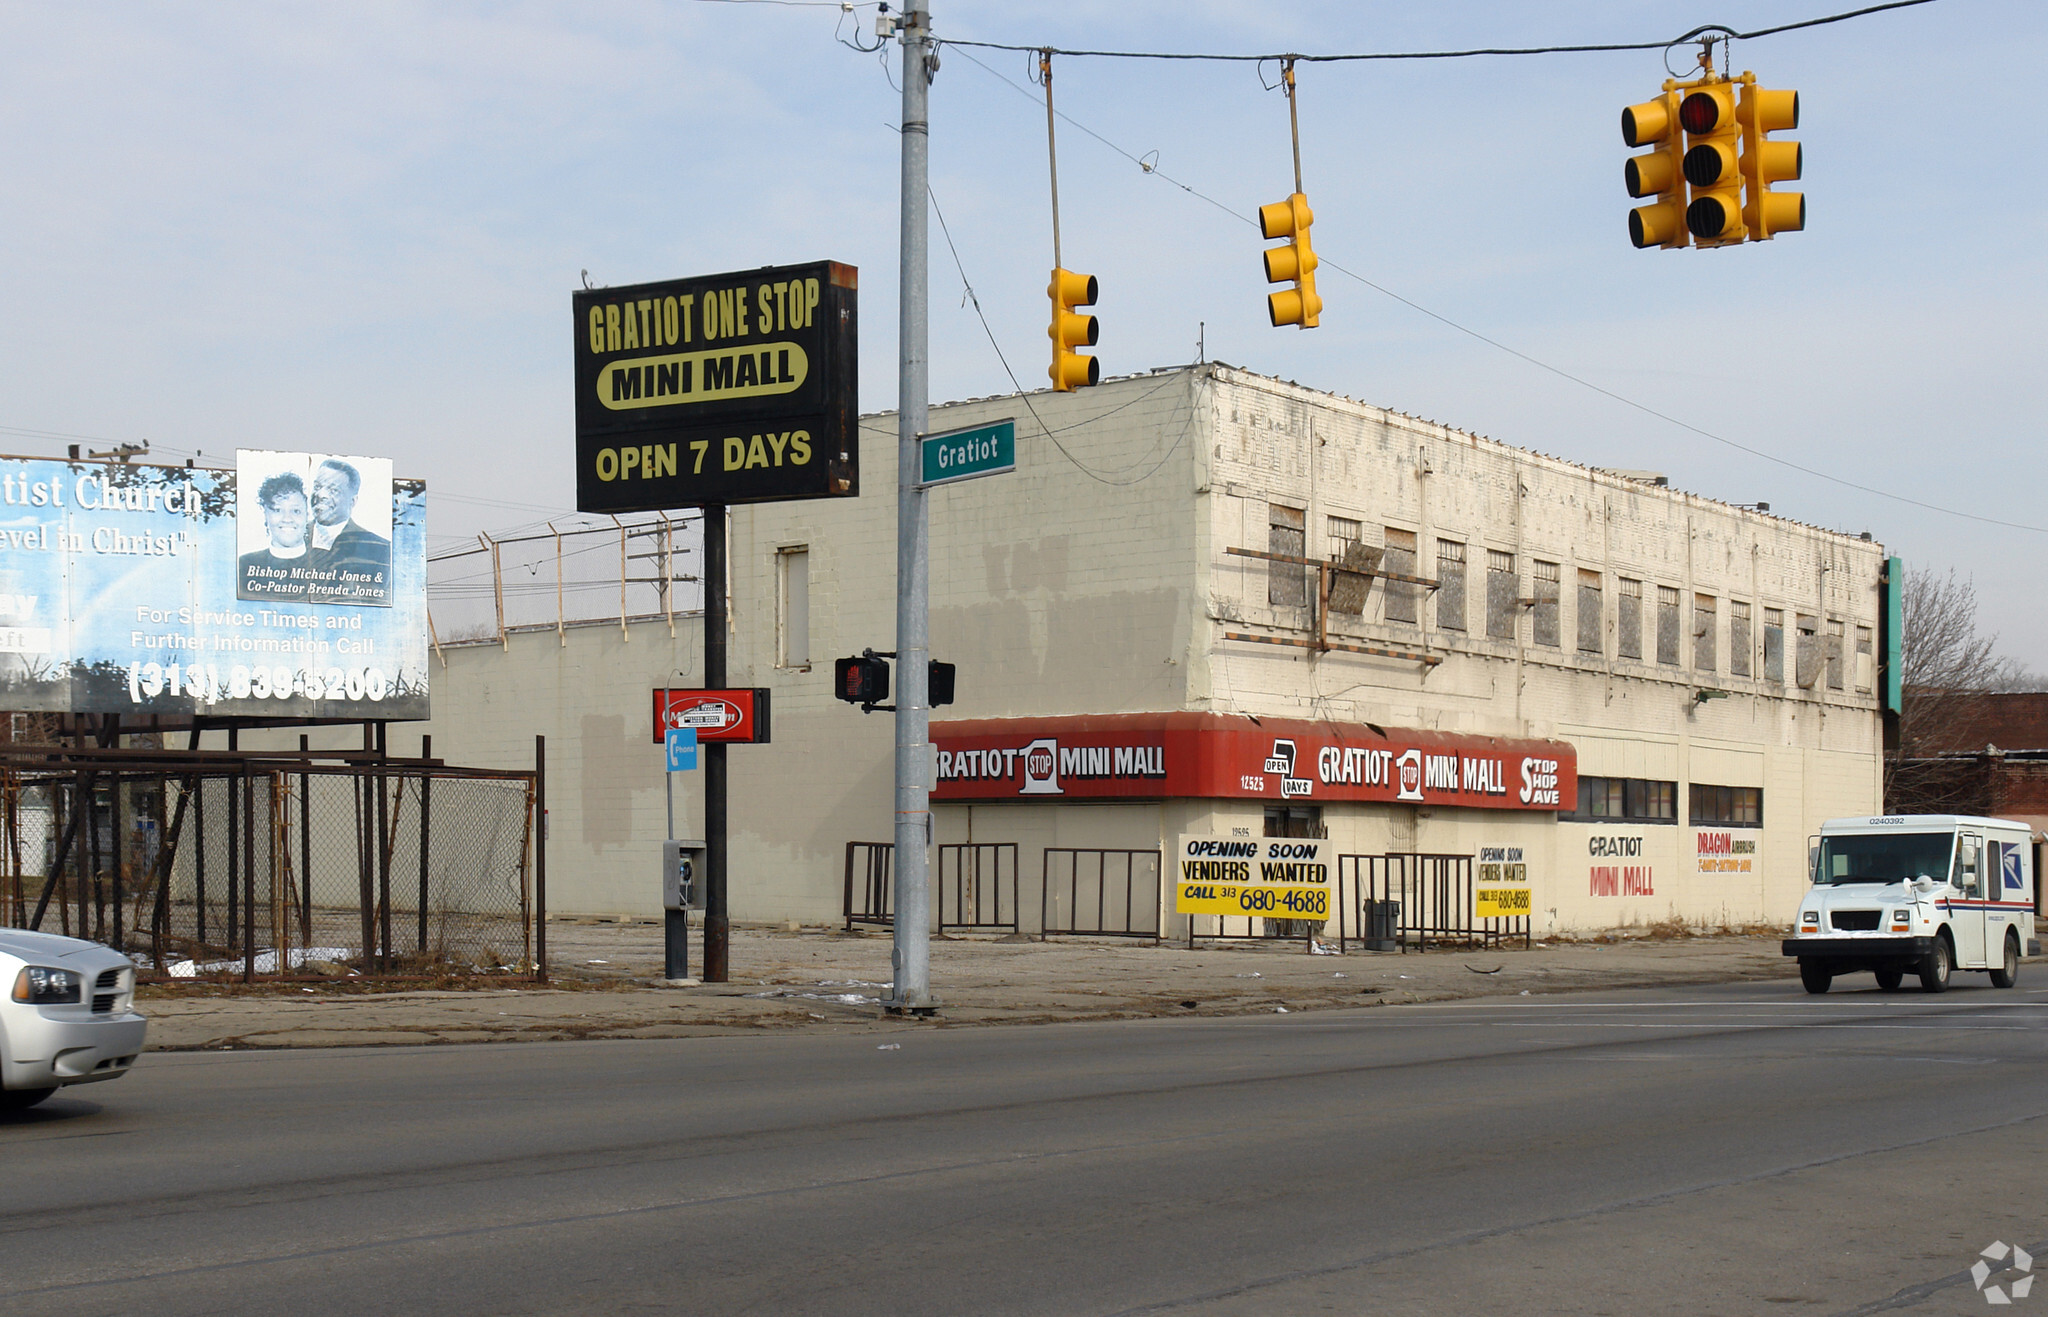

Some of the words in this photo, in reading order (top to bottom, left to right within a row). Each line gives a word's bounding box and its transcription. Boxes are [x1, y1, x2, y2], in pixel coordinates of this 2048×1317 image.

[589, 294, 694, 354] GRATIOT
[703, 287, 748, 341] ONE
[758, 278, 820, 334] STOP
[612, 361, 692, 401] MINI
[703, 349, 794, 391] MALL
[596, 443, 677, 481] OPEN
[690, 440, 709, 474] 7
[723, 430, 811, 471] DAYS
[938, 434, 998, 468] Gratiot
[75, 475, 203, 513] Church
[58, 525, 83, 552] in
[247, 565, 288, 581] Bishop
[290, 567, 336, 581] Michael
[339, 570, 372, 583] Jones
[374, 571, 383, 583] &
[247, 581, 304, 595] Co-Pastor
[307, 583, 349, 596] Brenda
[352, 585, 385, 598] Jones
[137, 606, 171, 623] For
[178, 607, 254, 626] Service
[259, 610, 319, 629] Times
[326, 614, 362, 630] and
[131, 632, 207, 650] Further
[214, 635, 330, 654] Information
[337, 638, 374, 655] Call
[129, 661, 218, 705] (313)
[230, 665, 386, 701] 839-5200
[675, 746, 694, 754] Phone
[1029, 755, 1051, 774] STOP
[1060, 747, 1110, 775] MINI
[1115, 747, 1166, 775] MALL
[1266, 760, 1287, 771] OPEN
[1318, 746, 1393, 785] GRATIOT
[1403, 766, 1418, 784] STOP
[1425, 755, 1458, 789] MINI
[1463, 758, 1506, 792] MALL
[1241, 775, 1264, 792] 12525
[1286, 781, 1308, 793] DAYS
[1187, 841, 1257, 858] OPENING
[1268, 843, 1318, 860] SOON
[1589, 837, 1643, 857] GRATIOT
[1698, 832, 1731, 855] DRAGON
[1182, 860, 1250, 882] VENDERS
[1260, 862, 1328, 883] WANTED
[1590, 866, 1618, 897] MINI
[1623, 866, 1654, 897] MALL
[1185, 886, 1216, 899] CALL
[1220, 888, 1236, 898] 313
[1240, 889, 1326, 914] 680-4688
